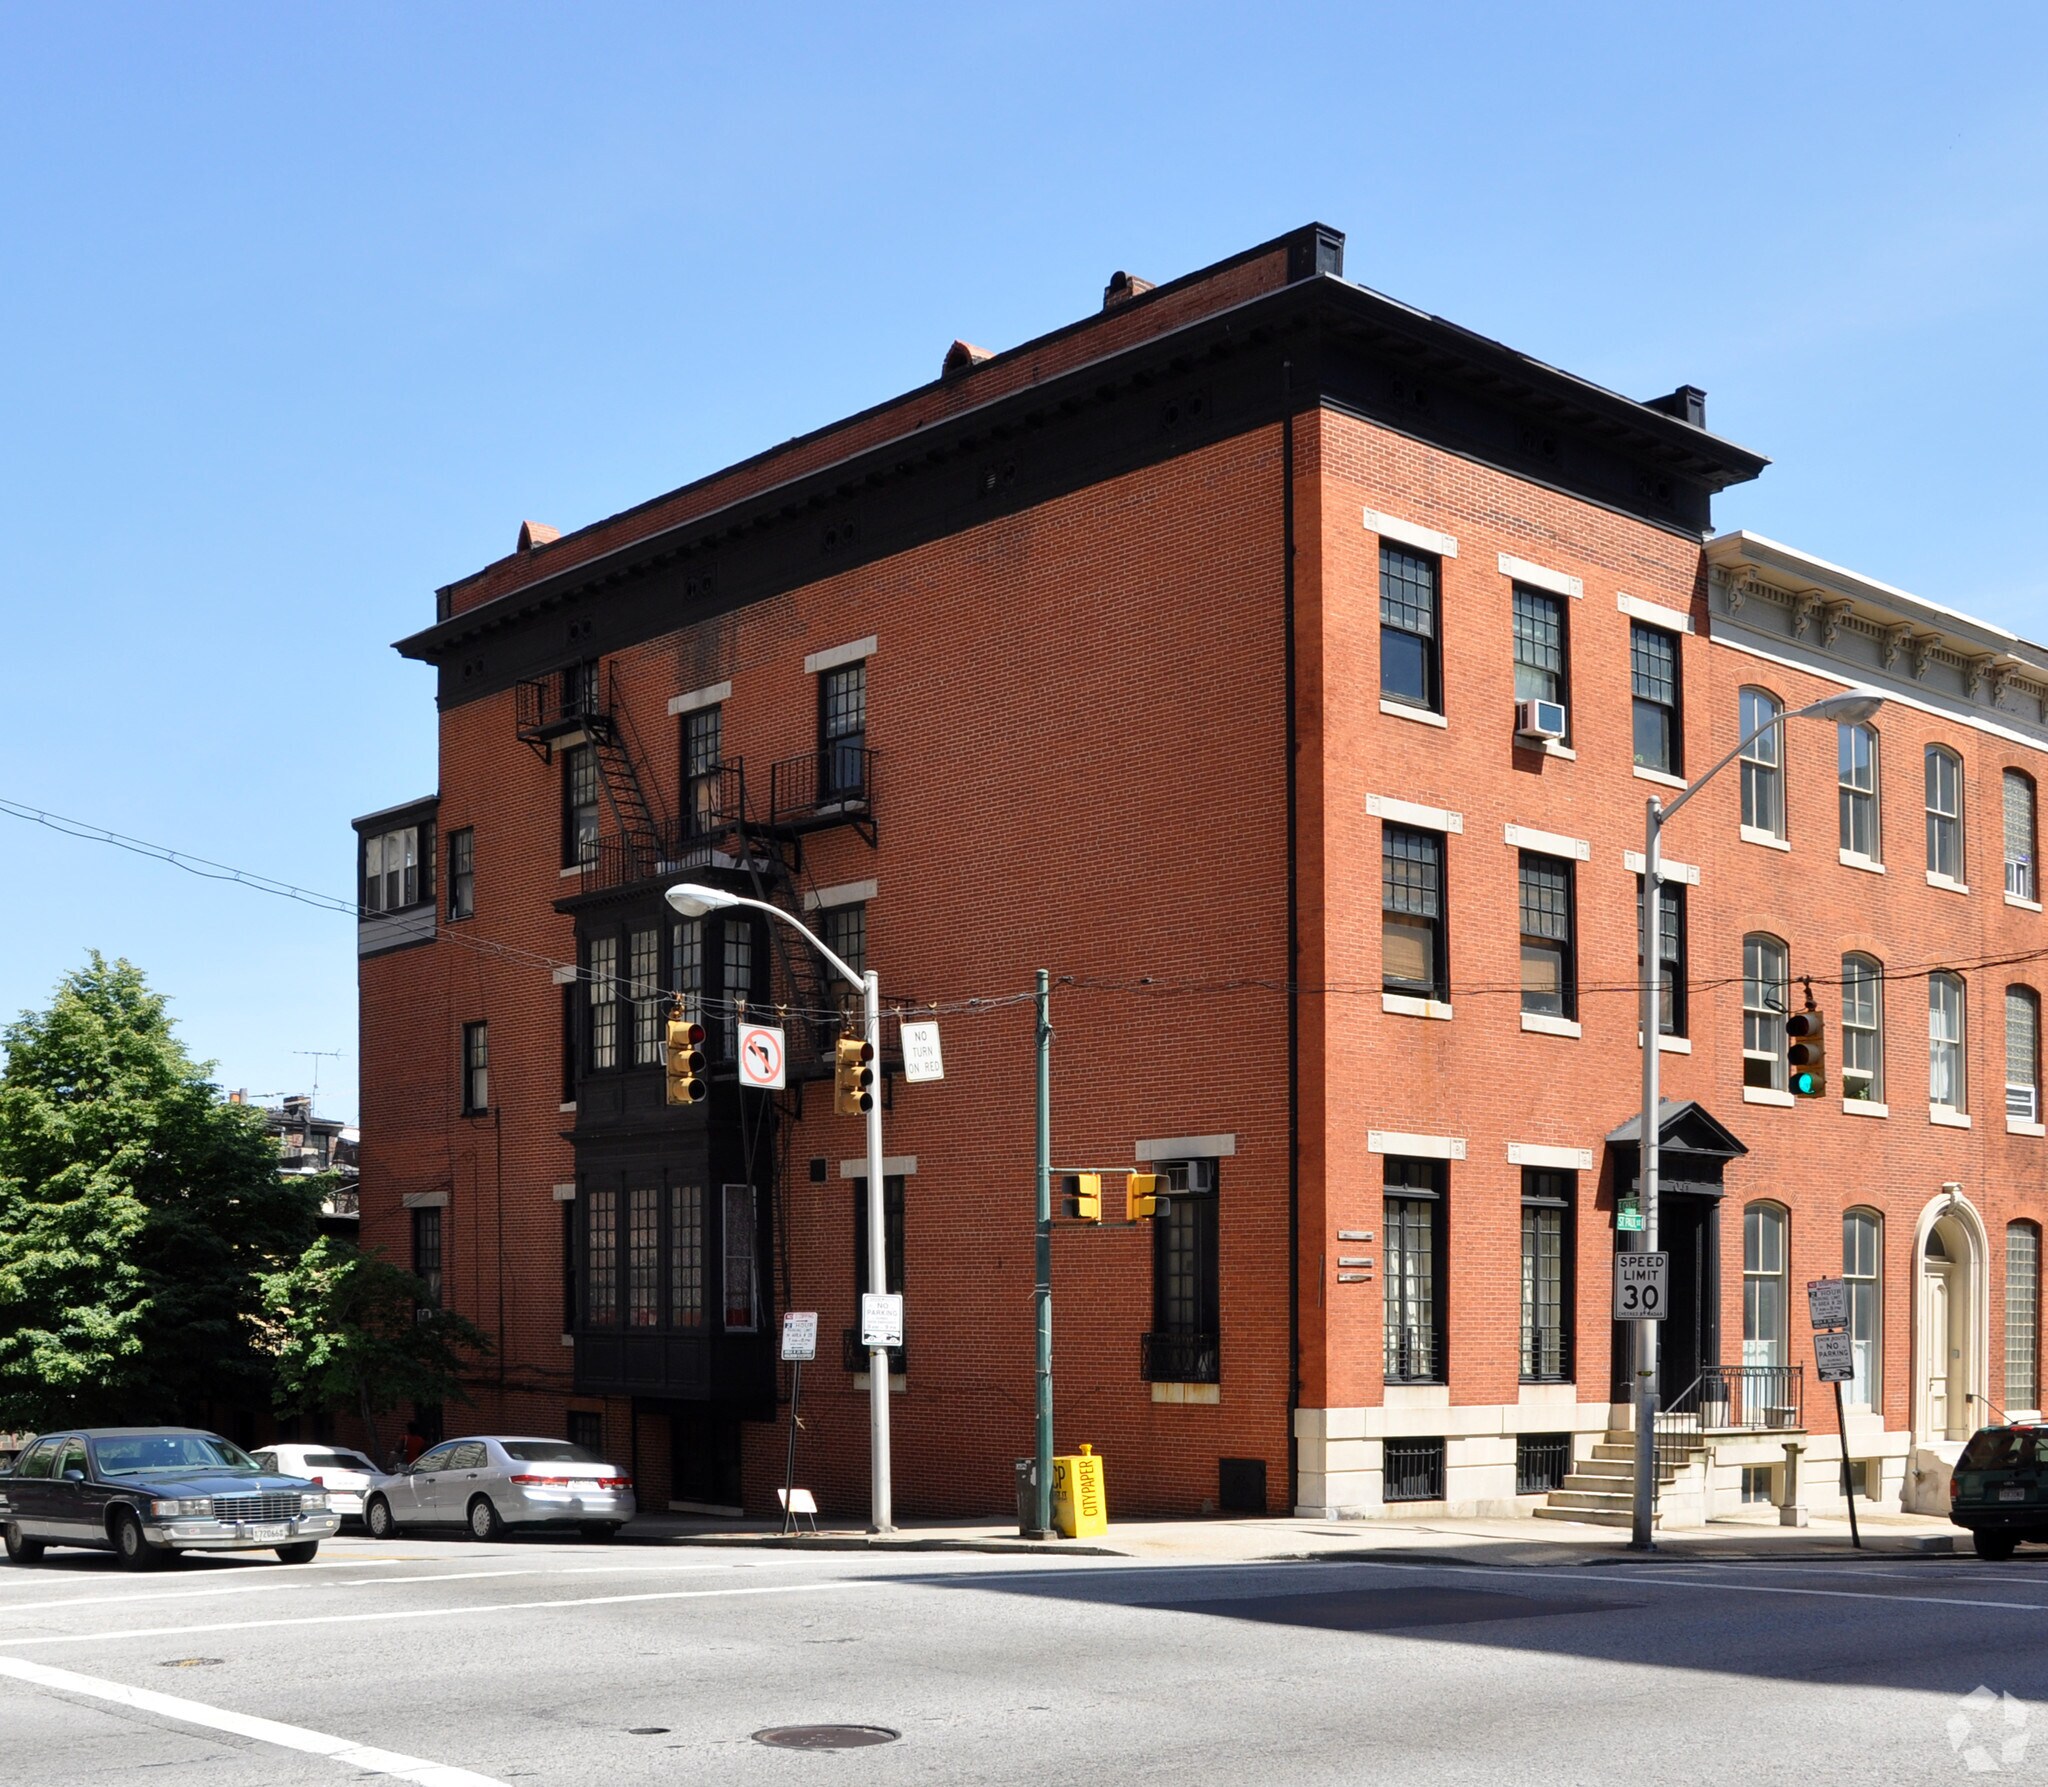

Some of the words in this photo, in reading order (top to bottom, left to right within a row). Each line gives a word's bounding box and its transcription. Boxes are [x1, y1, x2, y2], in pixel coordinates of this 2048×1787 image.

[914, 1031, 927, 1041] NO
[912, 1046, 934, 1057] TURN
[908, 1063, 920, 1074] ON
[924, 1061, 940, 1072] RED
[1620, 1256, 1664, 1268] SPEED
[1623, 1270, 1659, 1281] LIMIT
[1623, 1284, 1659, 1310] 30
[1821, 1289, 1842, 1297] HOUR
[877, 1302, 889, 1310] NO
[867, 1309, 898, 1317] PARKING
[1826, 1342, 1839, 1350] NO
[1819, 1349, 1849, 1358] PARKING
